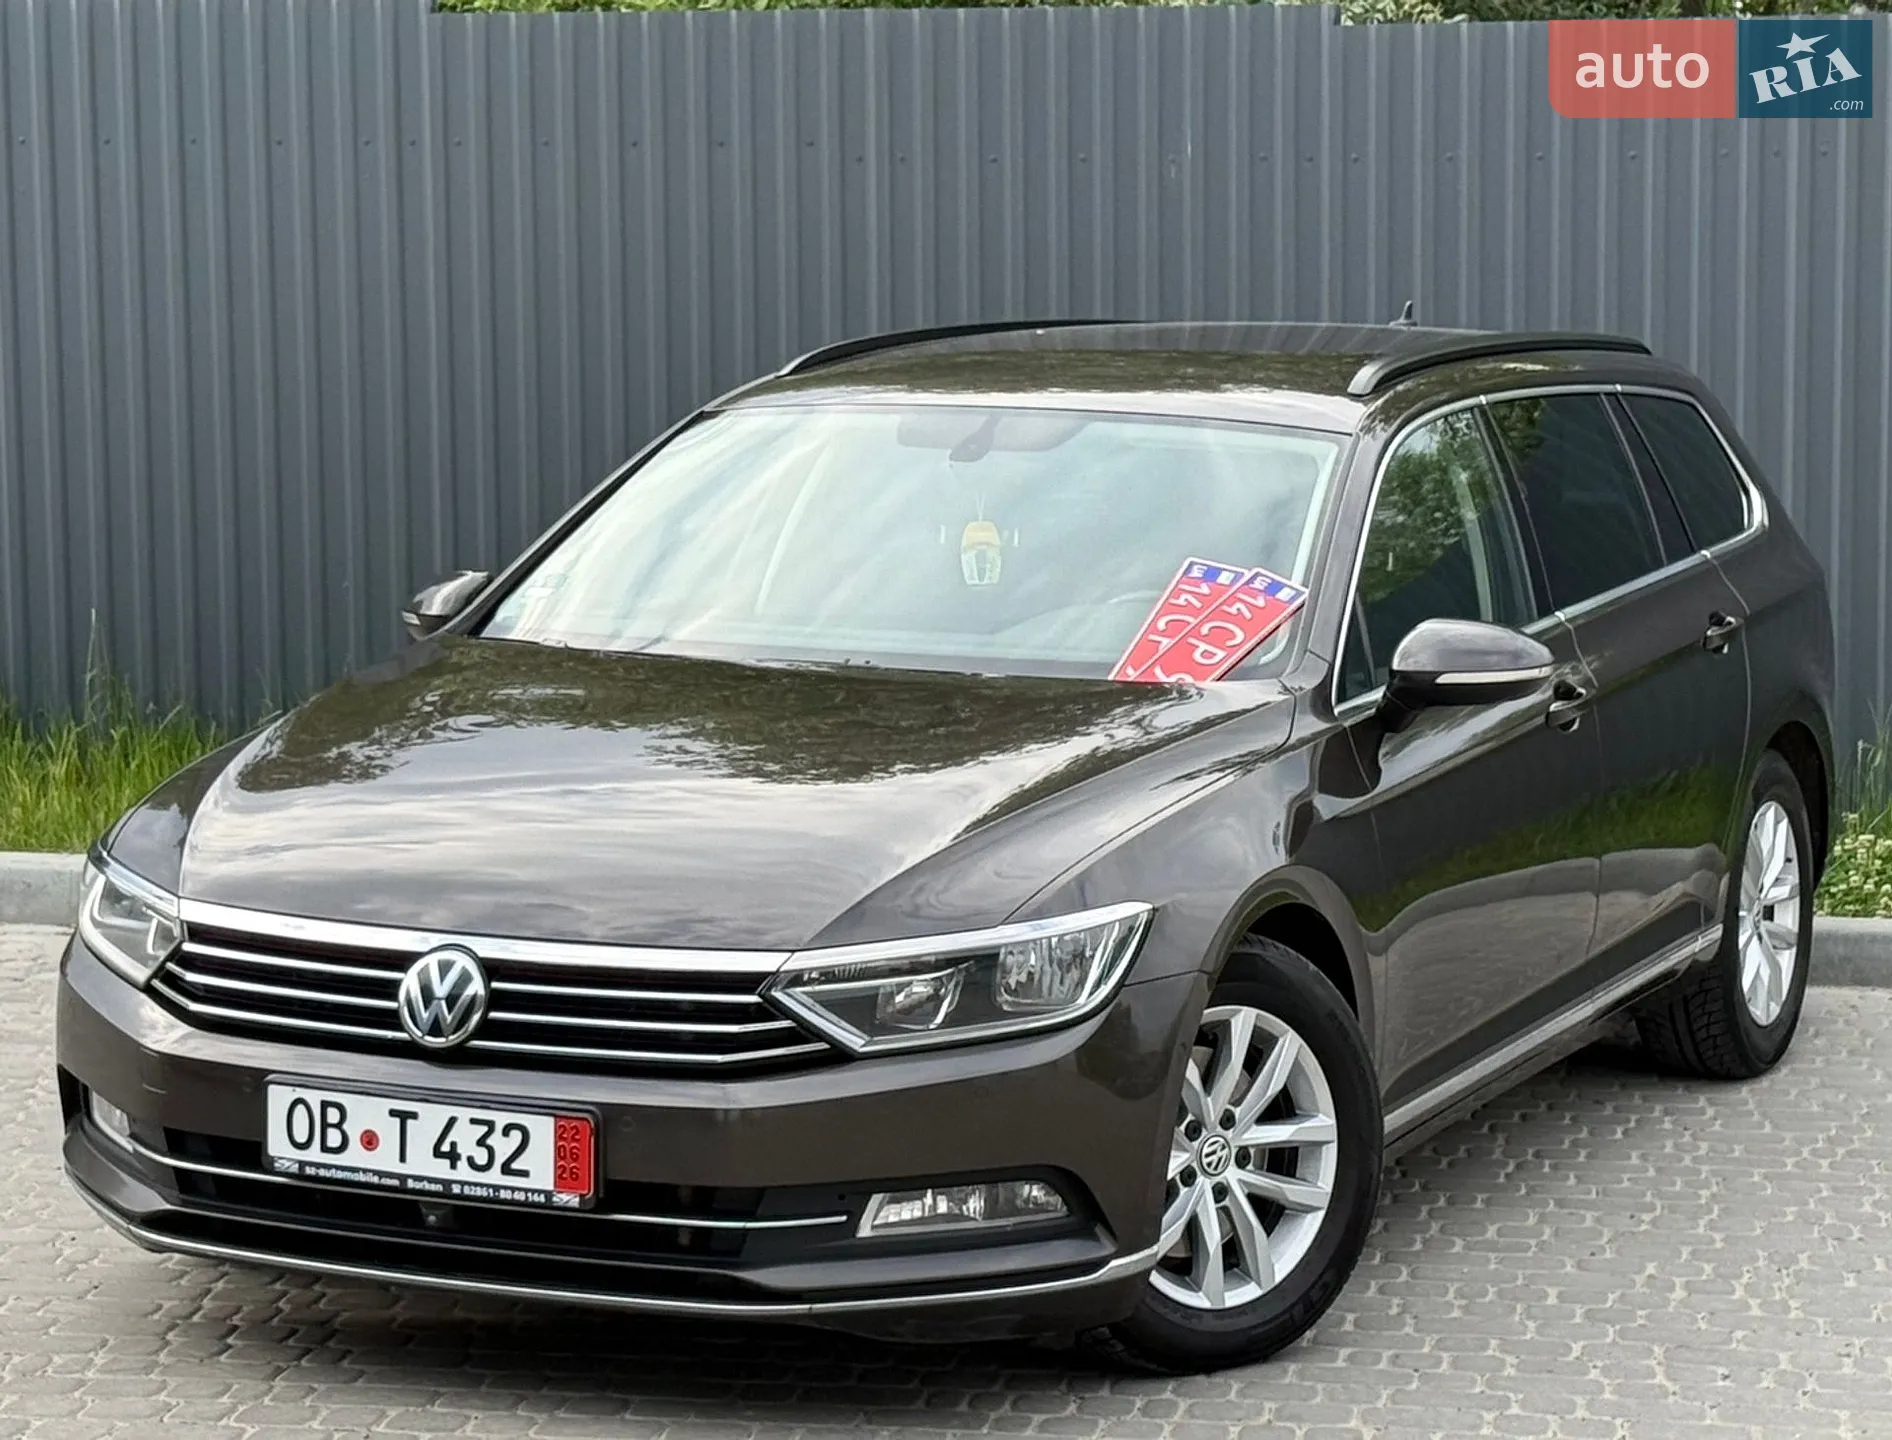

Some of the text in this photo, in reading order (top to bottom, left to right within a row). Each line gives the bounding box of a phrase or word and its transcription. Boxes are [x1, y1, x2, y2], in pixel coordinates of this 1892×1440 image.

[286, 1097, 531, 1178] OB T 432
[557, 1122, 581, 1142] 22
[557, 1143, 581, 1163] 06
[557, 1162, 581, 1182] 26
